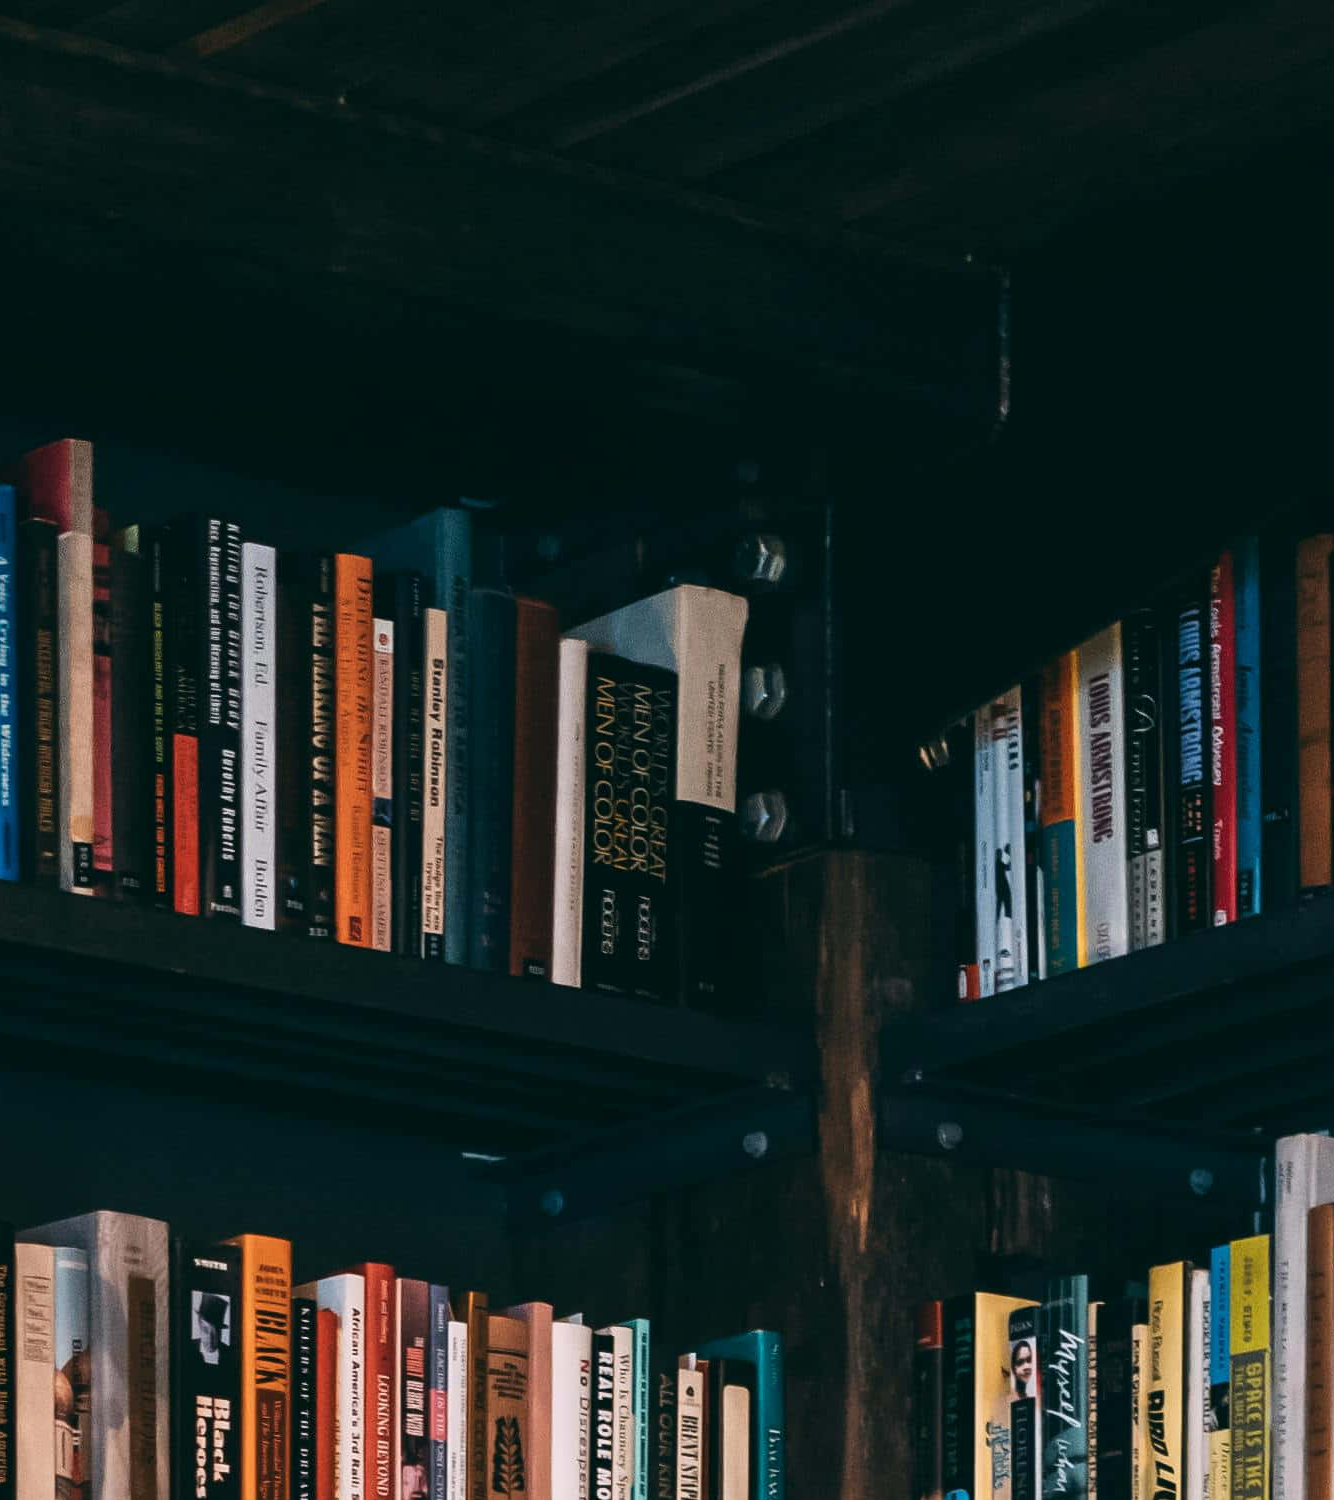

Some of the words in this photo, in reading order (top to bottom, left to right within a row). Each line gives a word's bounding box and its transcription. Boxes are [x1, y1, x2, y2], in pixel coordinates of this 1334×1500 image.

[595, 676, 614, 736] MEN
[1088, 673, 1111, 729] LOUIS
[251, 721, 268, 777] Family
[595, 741, 614, 775] OF
[253, 783, 269, 833] Affair
[1090, 732, 1115, 843] ARMSTRONG
[592, 780, 614, 865] COLOR
[376, 1373, 391, 1435] LOOKING
[597, 1352, 614, 1402] REAL
[1242, 1362, 1263, 1425] SPACE
[193, 1395, 212, 1499] Heroes
[212, 1399, 231, 1482] Black
[596, 1408, 613, 1460] ROLE
[1244, 1429, 1263, 1447] IS
[376, 1440, 391, 1496] BEYOND
[1244, 1451, 1263, 1490] THE
